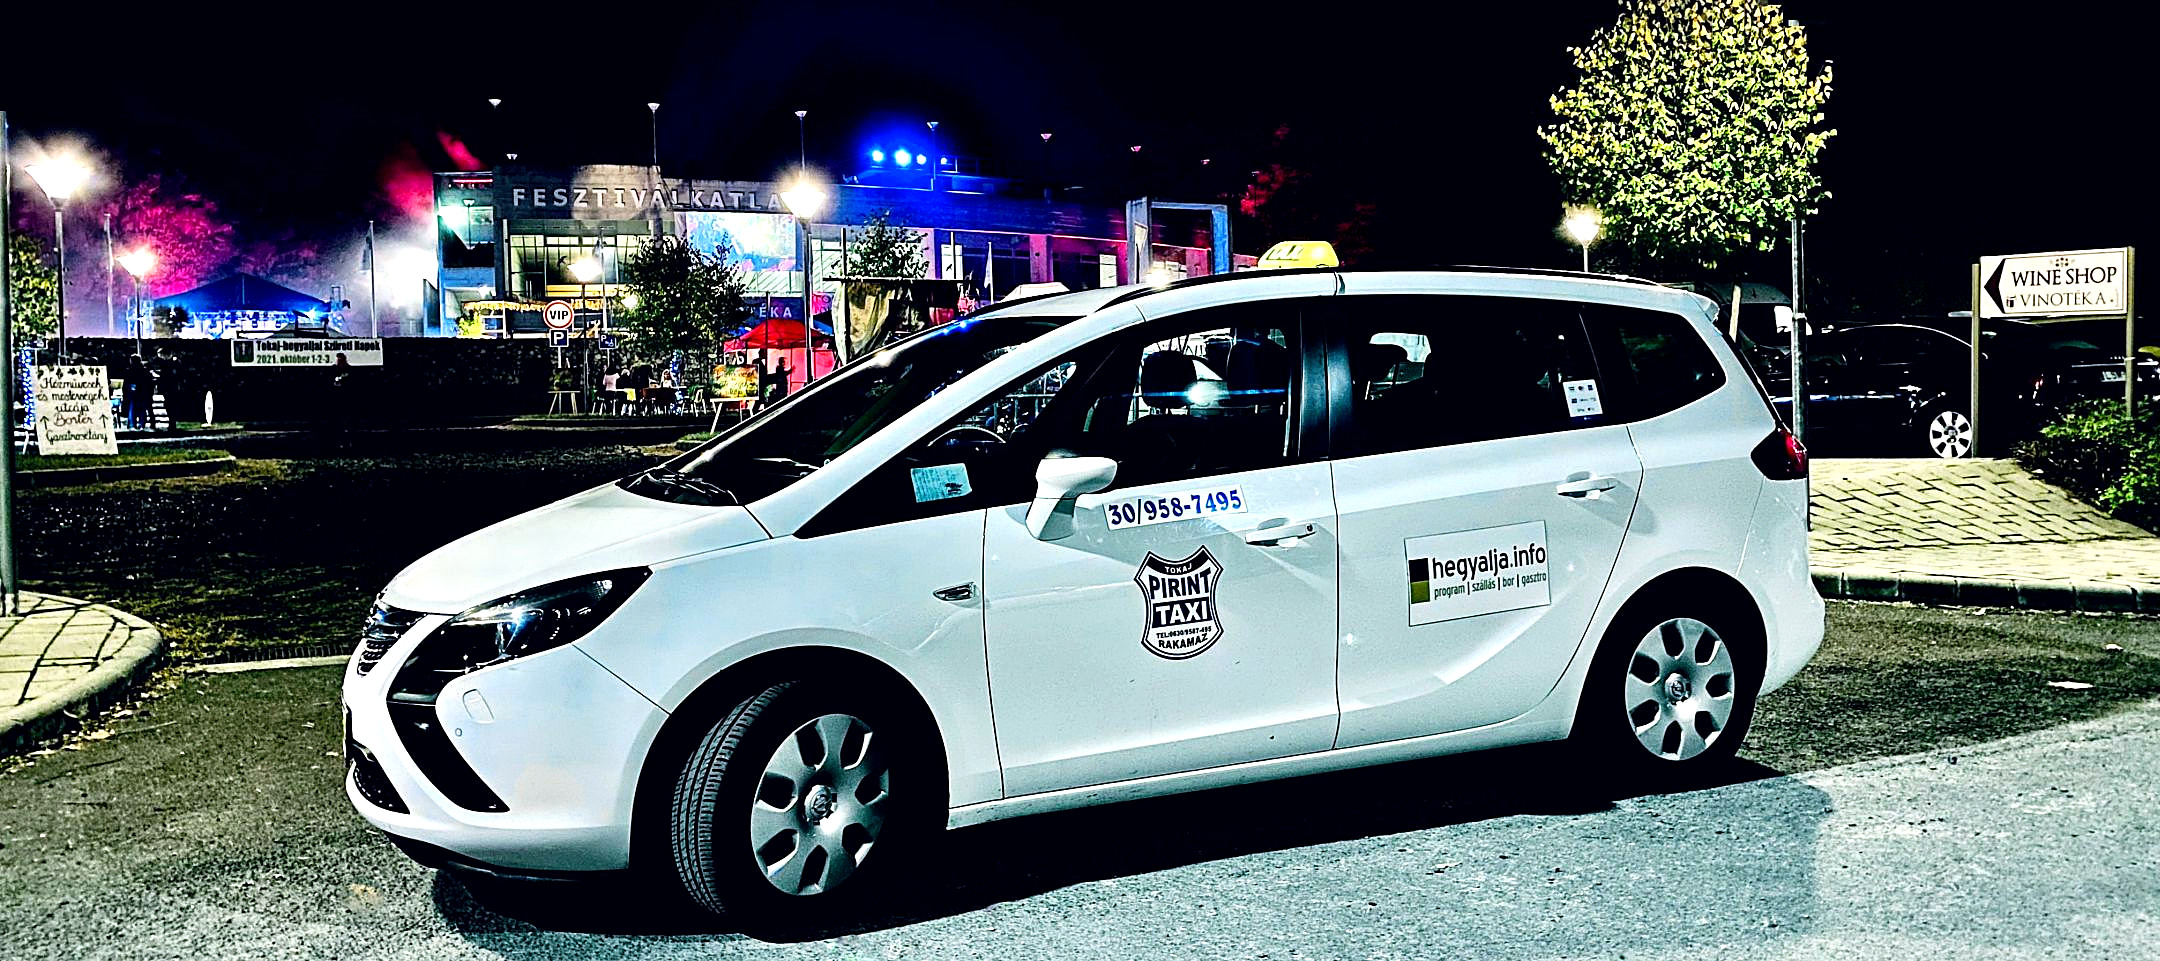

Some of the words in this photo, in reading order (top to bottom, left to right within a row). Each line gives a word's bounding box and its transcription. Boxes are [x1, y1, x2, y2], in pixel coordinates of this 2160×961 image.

[512, 183, 801, 211] FESZTIVÁLKATLA
[2011, 269, 2061, 287] WINE
[2066, 266, 2117, 284] SHOP
[2020, 289, 2106, 307] VINOTÉKA
[549, 310, 569, 320] VIP
[553, 331, 565, 345] P
[600, 334, 607, 342] P
[256, 354, 279, 364] 2021.
[280, 354, 310, 364] október
[1108, 489, 1242, 525] 30/958-7495
[1164, 562, 1192, 574] TOKAJ
[1432, 543, 1546, 581] hegyalja.info
[1148, 566, 1212, 600] PIRINT
[1434, 584, 1466, 600] program
[1472, 578, 1496, 592] szállás
[1502, 576, 1515, 588] bor
[1521, 571, 1547, 586] gasztro
[1155, 600, 1208, 626] TAXI
[1158, 632, 1208, 650] RAKAMAZ
